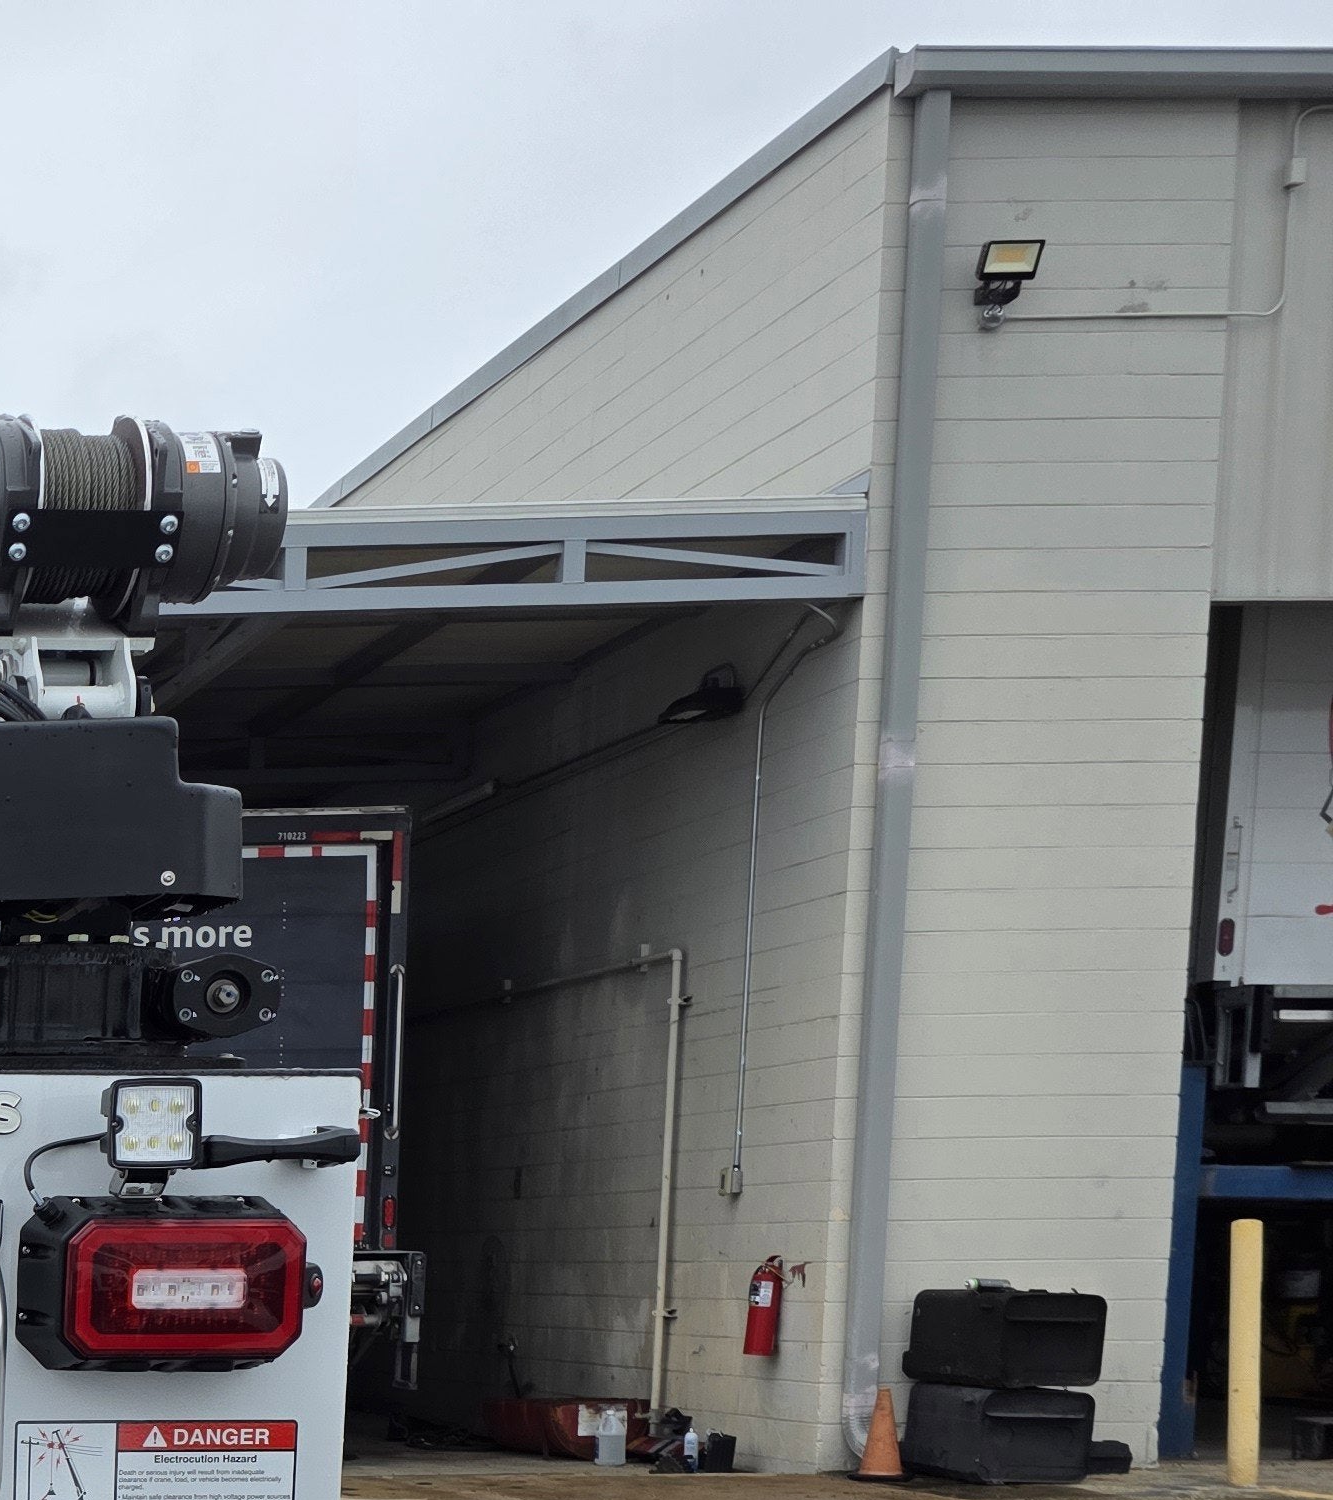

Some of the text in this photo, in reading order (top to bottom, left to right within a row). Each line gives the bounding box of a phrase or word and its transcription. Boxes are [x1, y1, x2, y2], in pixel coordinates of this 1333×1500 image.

[278, 831, 307, 841] 710223
[161, 925, 253, 948] more
[173, 1428, 270, 1445] DANGER
[154, 1454, 258, 1464] Electrocution Hazard
